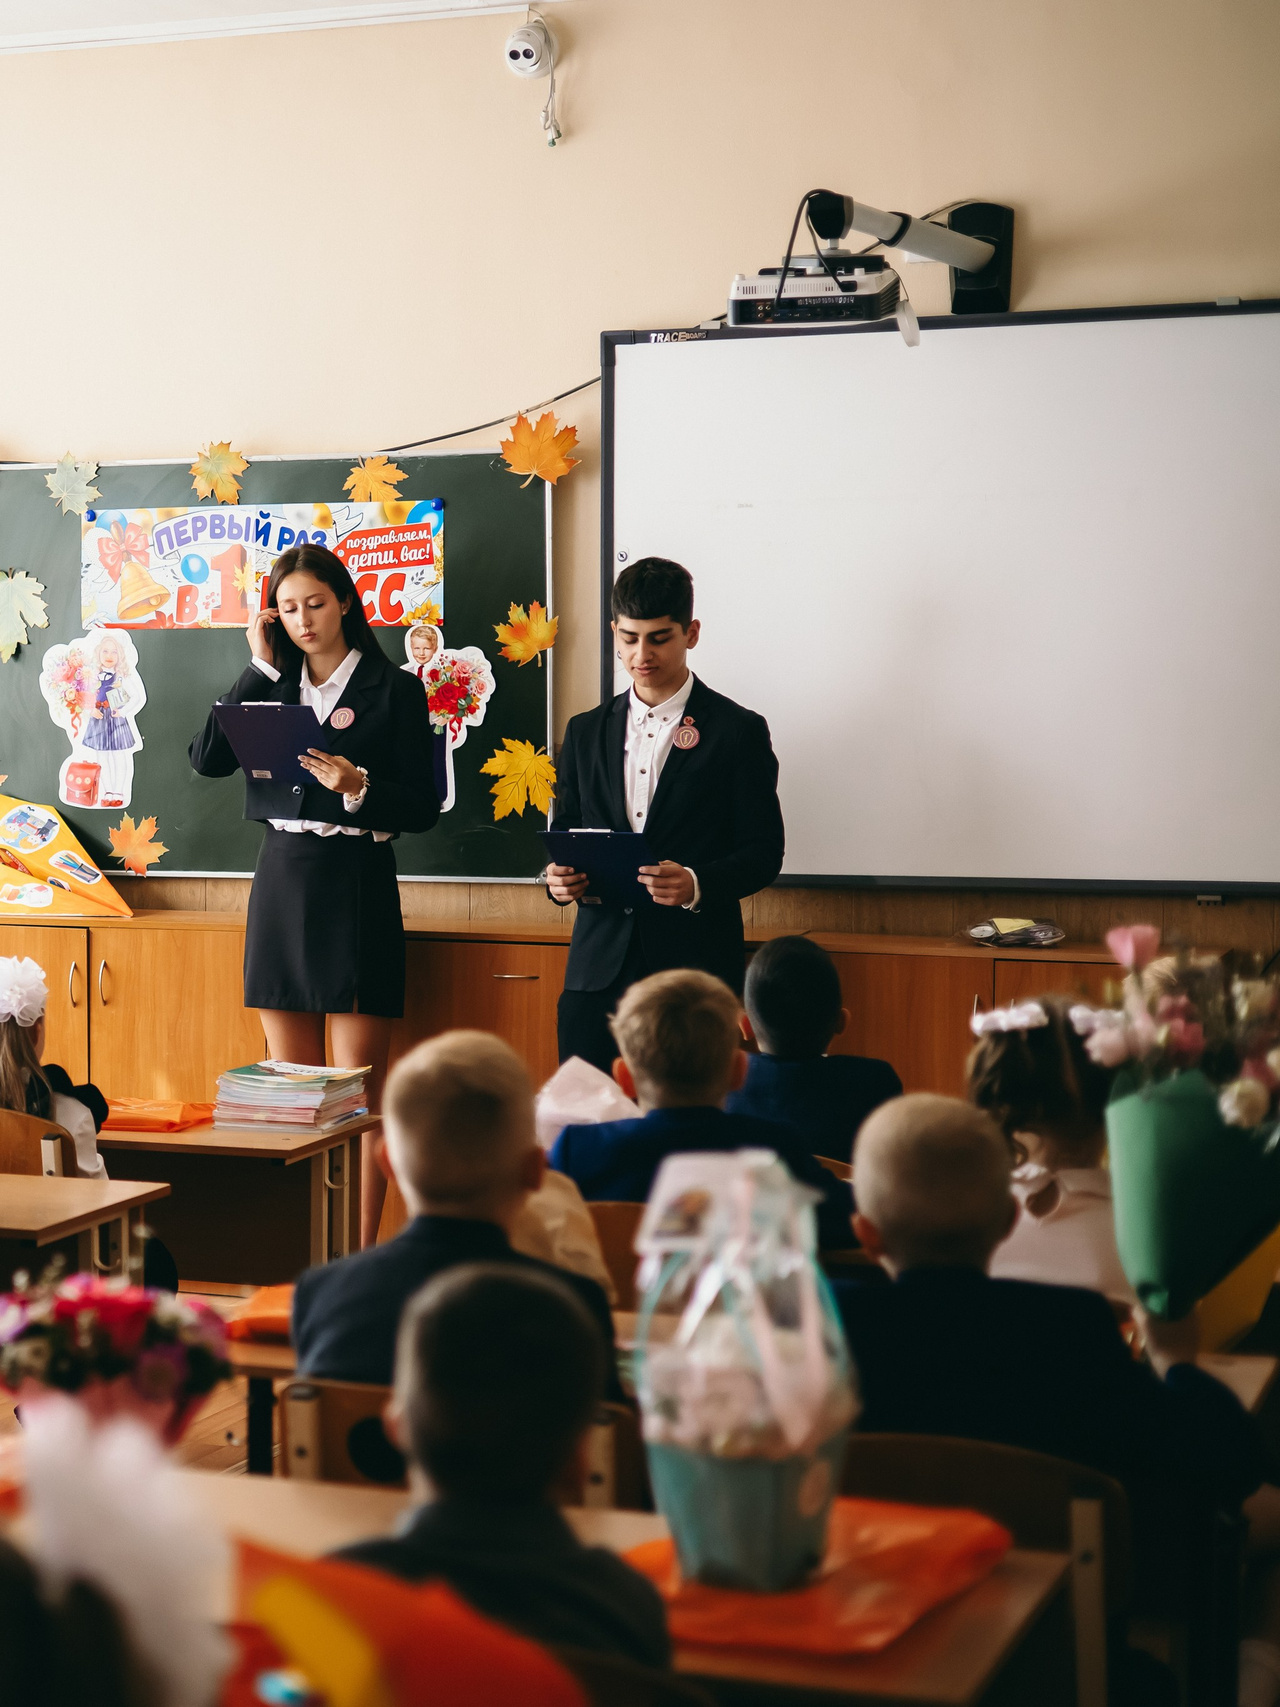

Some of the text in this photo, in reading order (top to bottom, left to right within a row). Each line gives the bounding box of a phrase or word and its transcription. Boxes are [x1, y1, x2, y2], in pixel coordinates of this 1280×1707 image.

[154, 510, 328, 555] ПЕРВЫЙ РАЗ
[346, 529, 431, 551] поздравляем,
[347, 543, 431, 574] дети, вас!
[210, 544, 250, 623] 1
